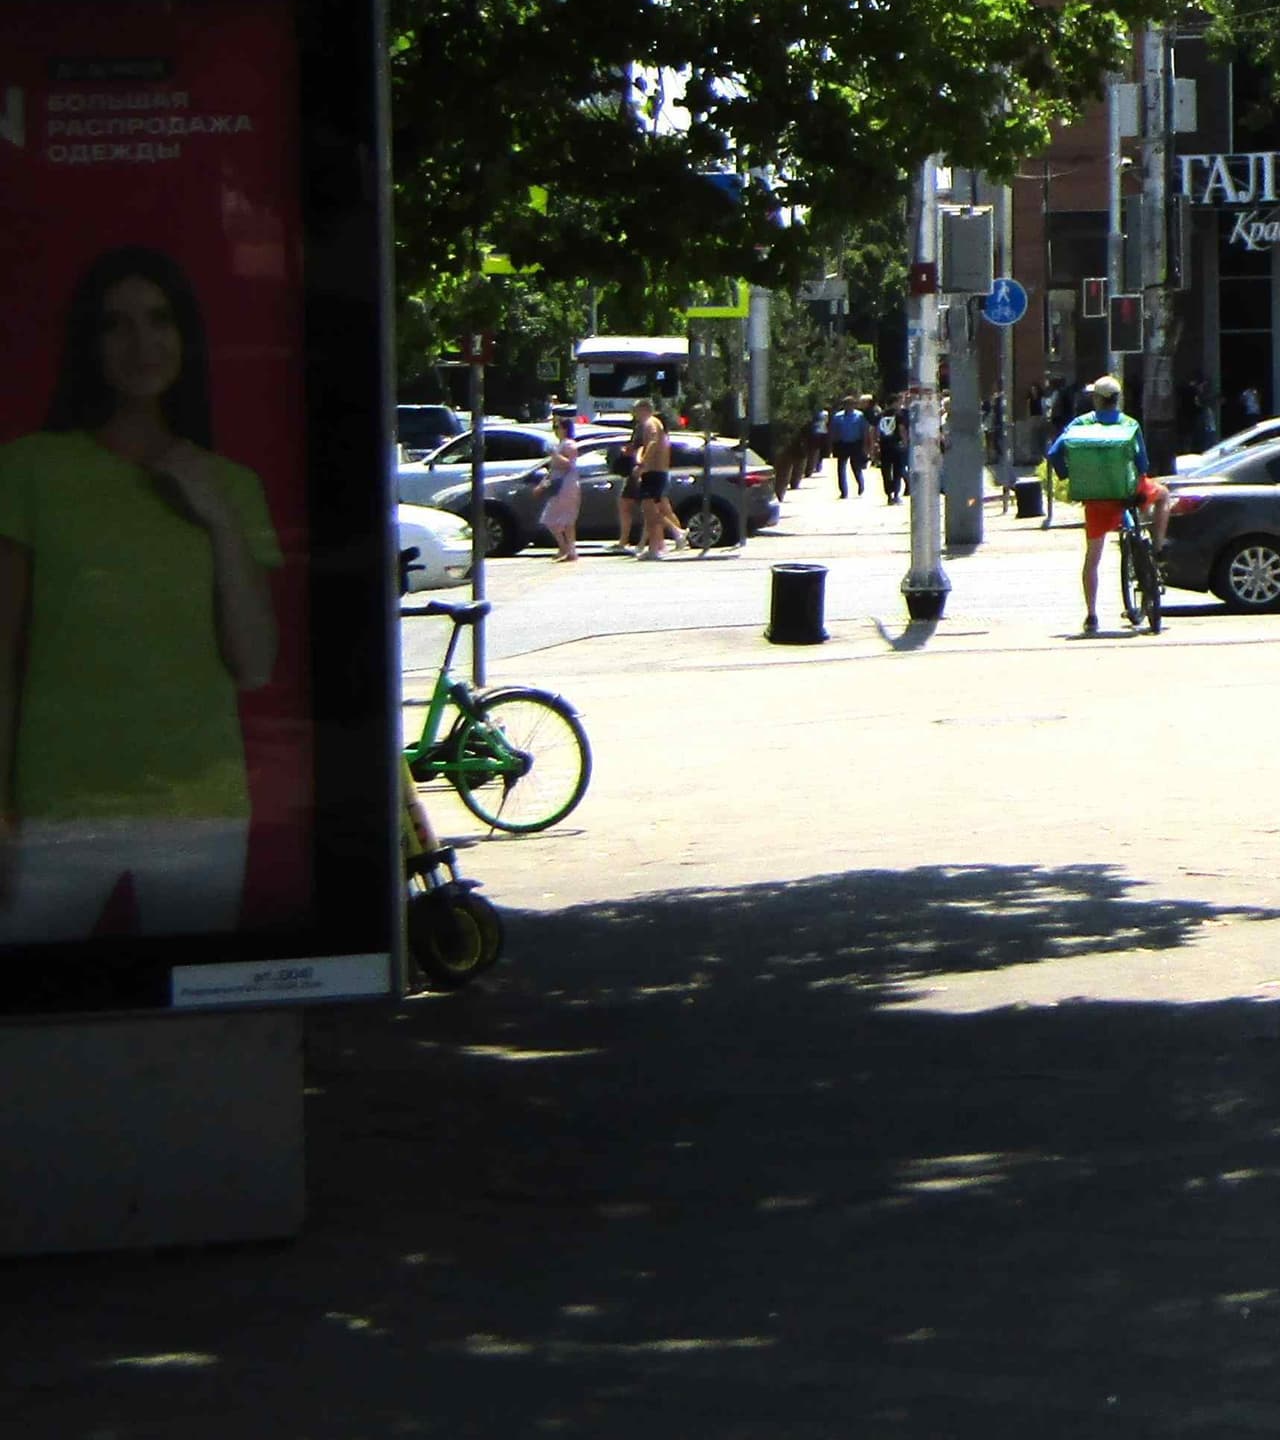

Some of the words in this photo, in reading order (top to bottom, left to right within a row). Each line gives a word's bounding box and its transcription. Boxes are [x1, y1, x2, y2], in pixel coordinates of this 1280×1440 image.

[47, 90, 190, 112] БОЛЬШАЯ
[47, 113, 254, 139] РАСПРОДАЖА
[47, 141, 182, 164] ОДЕЖДЫ
